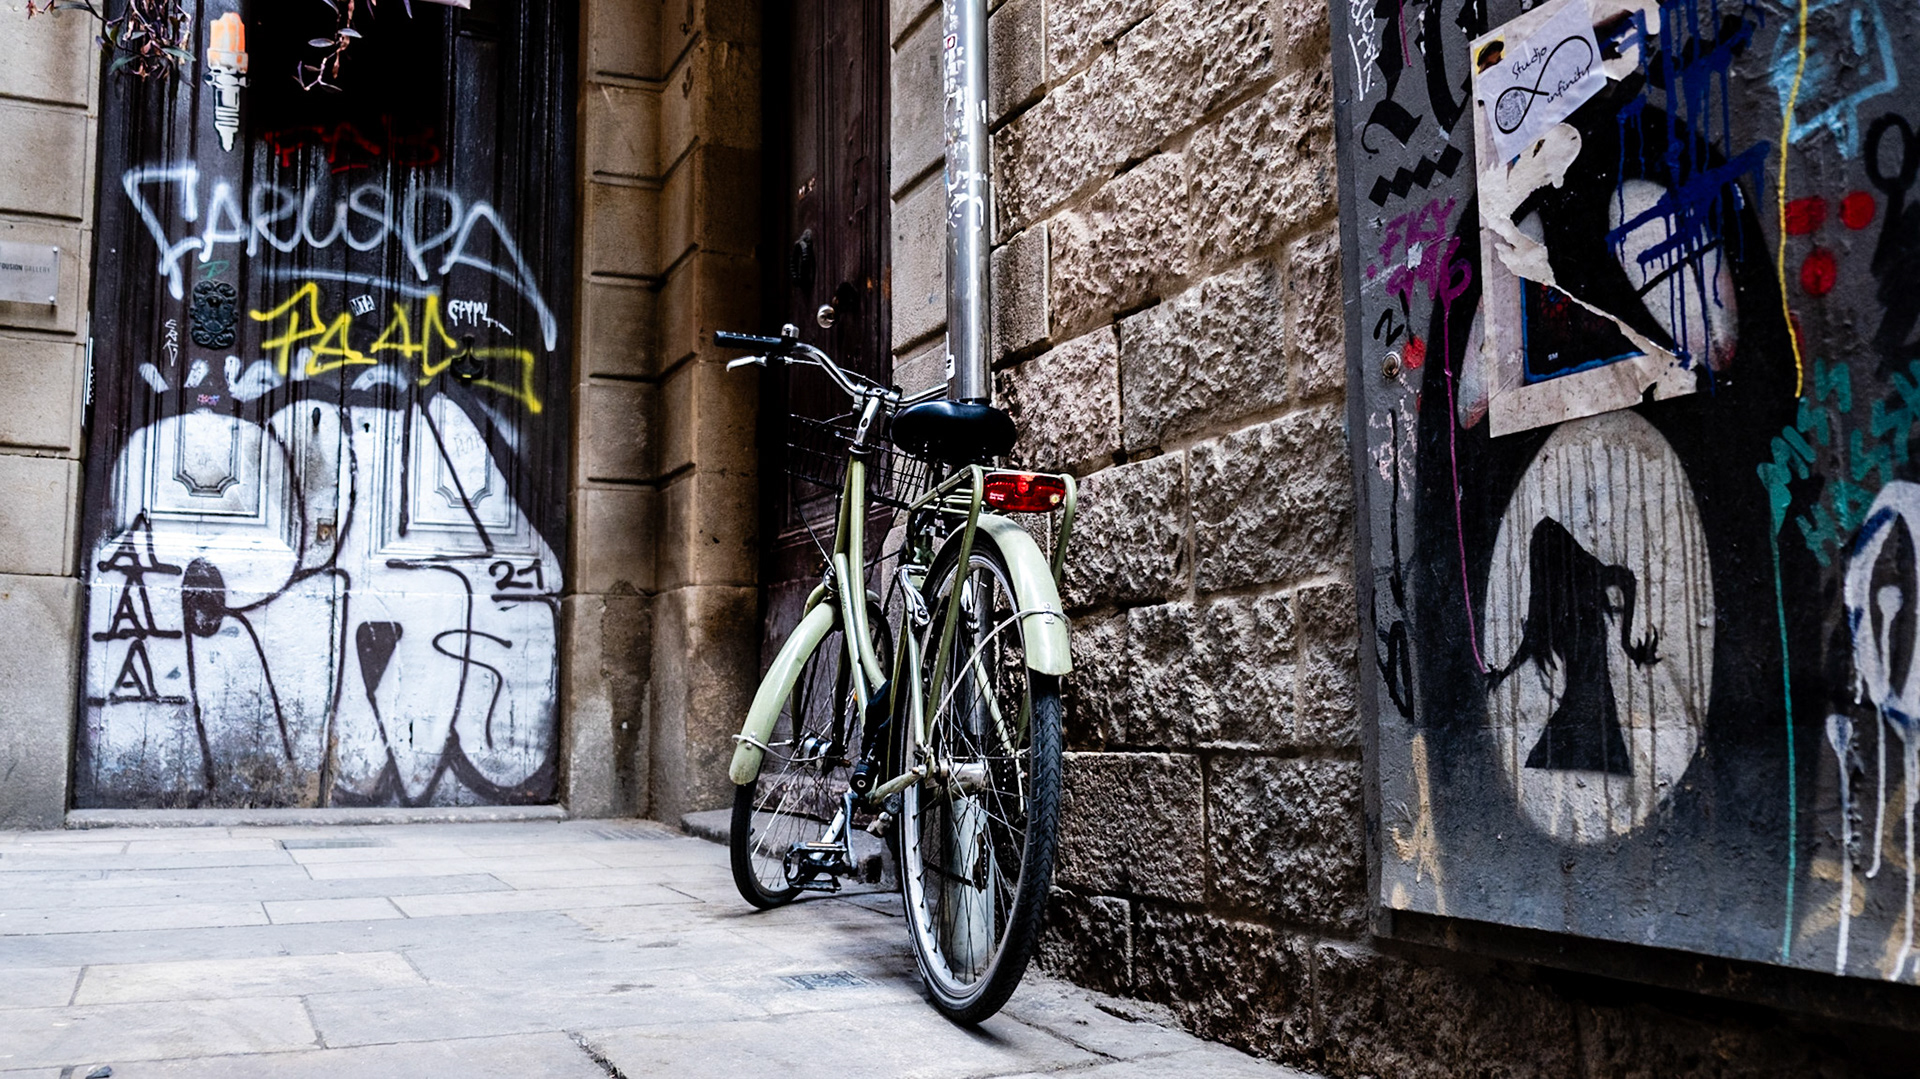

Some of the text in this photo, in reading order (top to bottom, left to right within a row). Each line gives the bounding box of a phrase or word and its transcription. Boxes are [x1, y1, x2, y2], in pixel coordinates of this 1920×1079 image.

[0, 262, 50, 273] OUSION GALLERY
[488, 558, 544, 591] 21
